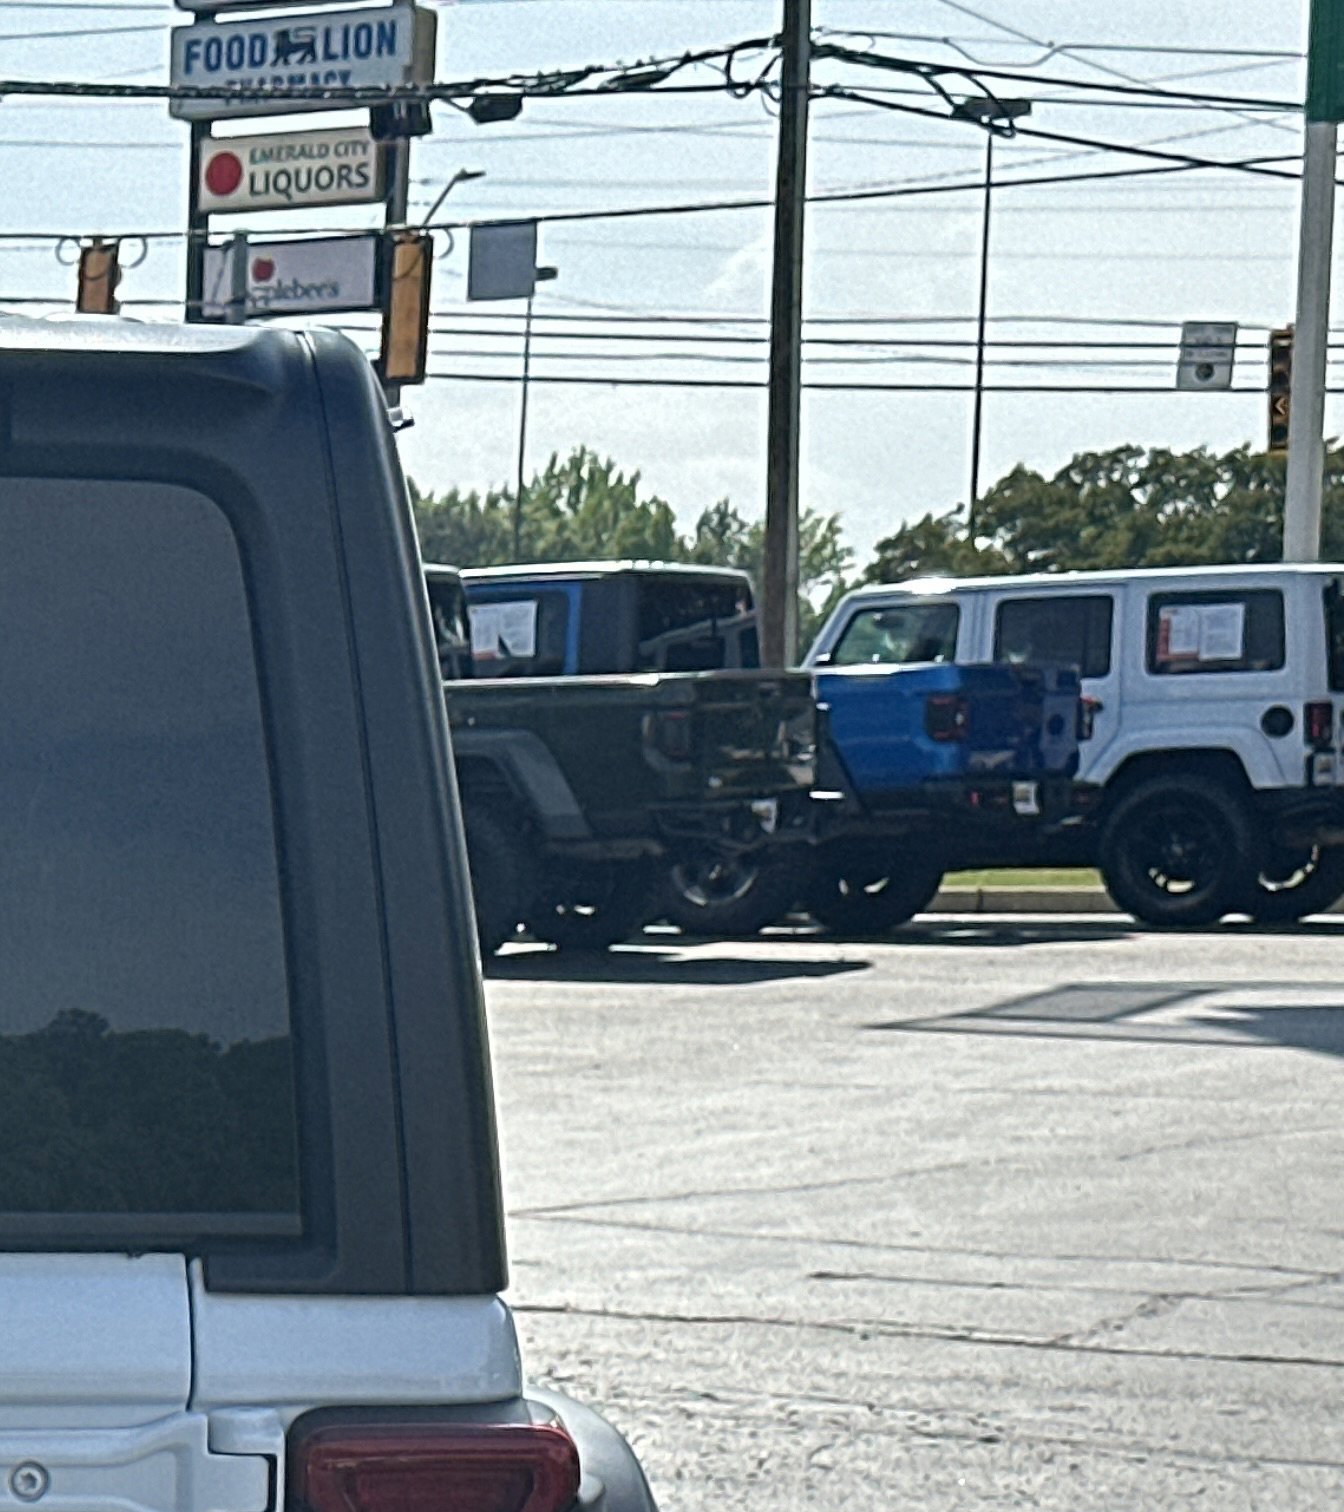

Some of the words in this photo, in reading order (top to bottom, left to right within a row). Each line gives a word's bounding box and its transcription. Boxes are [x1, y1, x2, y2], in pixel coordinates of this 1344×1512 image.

[184, 33, 269, 75] FOOD
[321, 19, 397, 61] LION
[248, 143, 330, 164] EMERALD
[333, 139, 370, 158] CITY
[248, 162, 370, 201] LIQUORS
